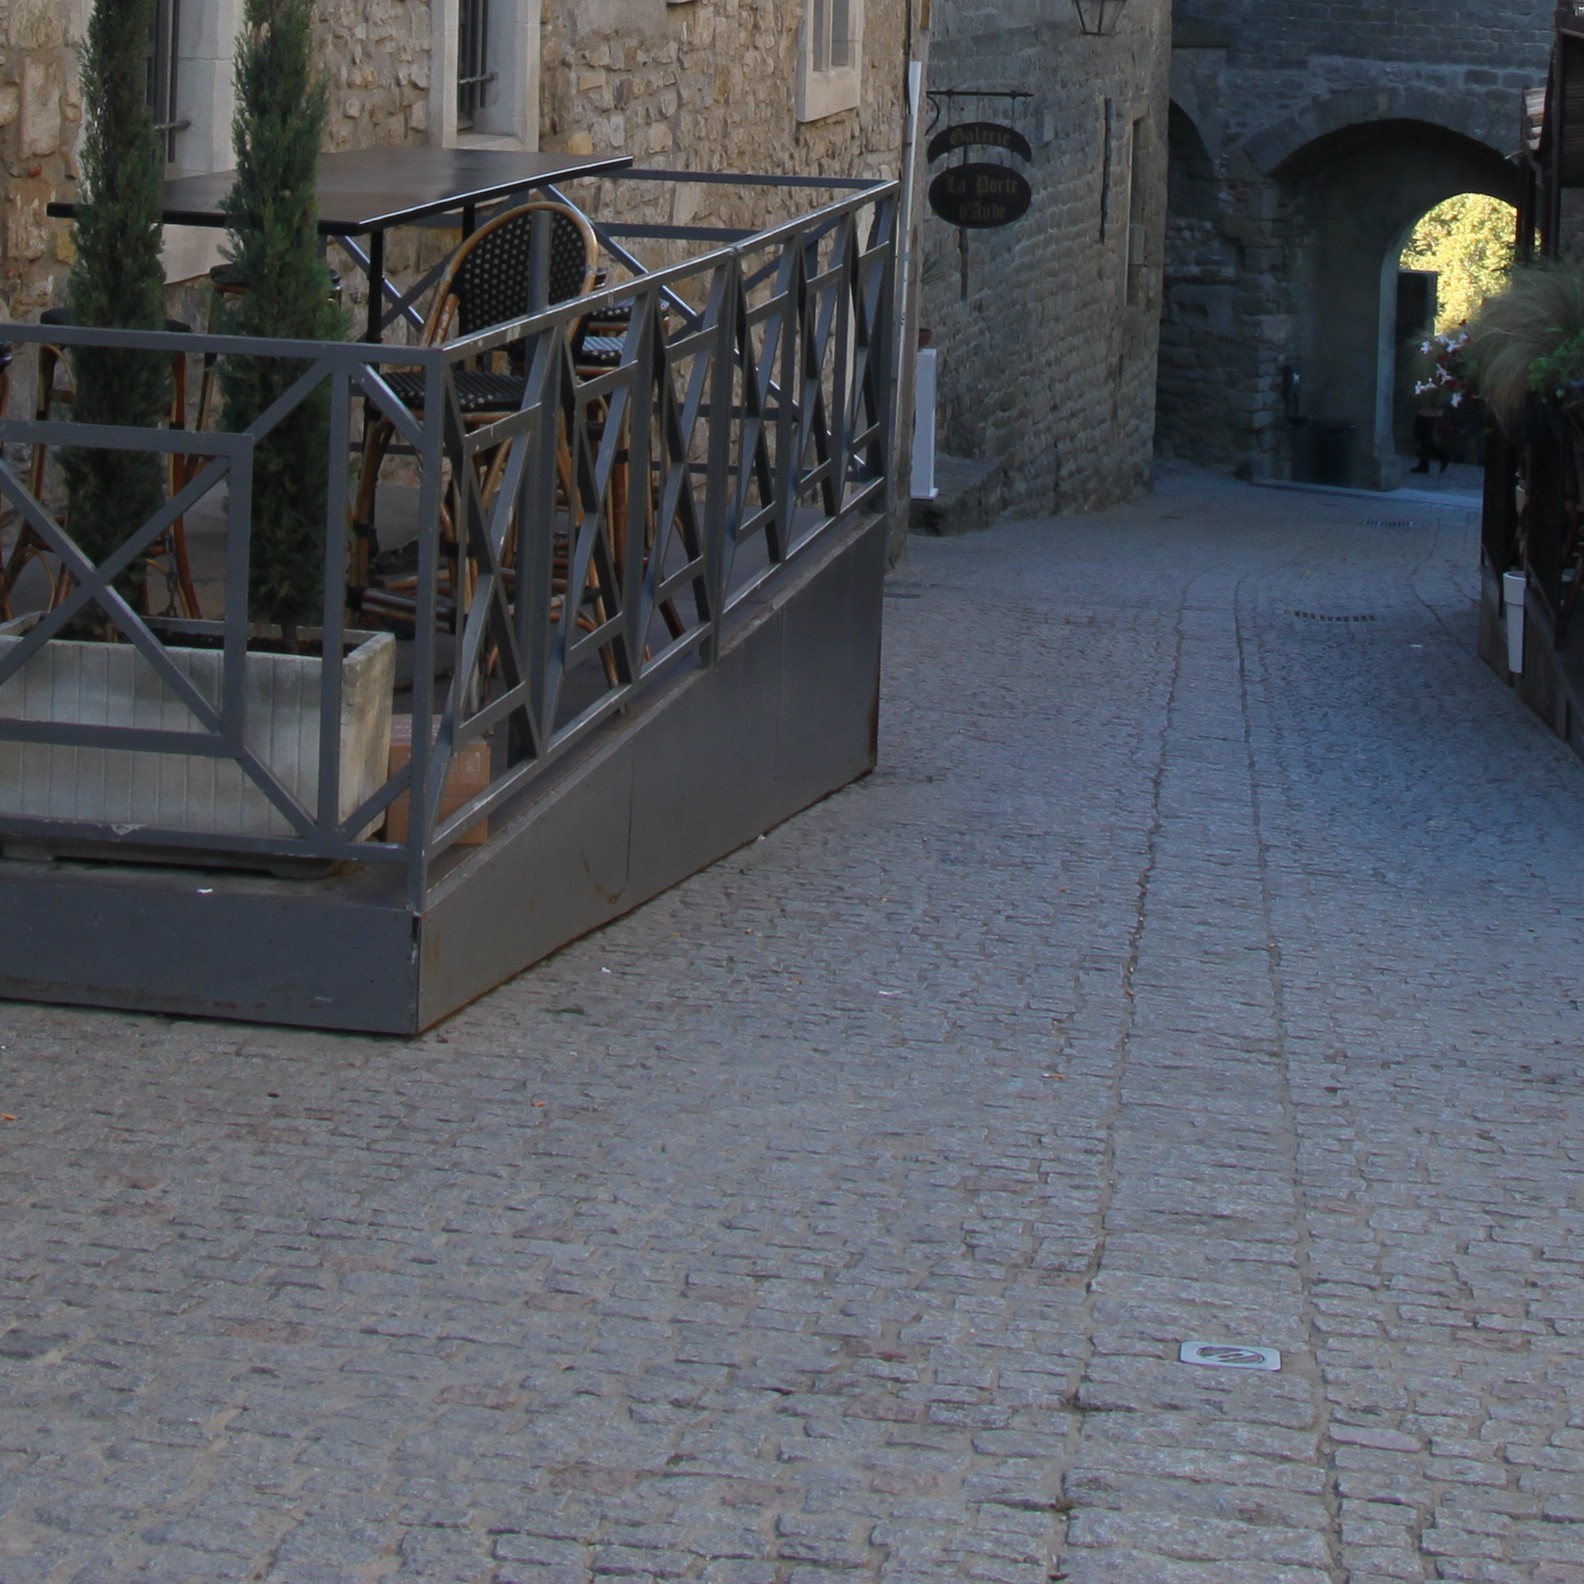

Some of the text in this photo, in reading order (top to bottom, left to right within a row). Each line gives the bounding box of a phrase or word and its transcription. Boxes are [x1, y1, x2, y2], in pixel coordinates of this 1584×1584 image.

[950, 126, 1011, 146] Galerie
[947, 173, 1018, 198] La Porte
[959, 201, 1007, 221] d'Aude
